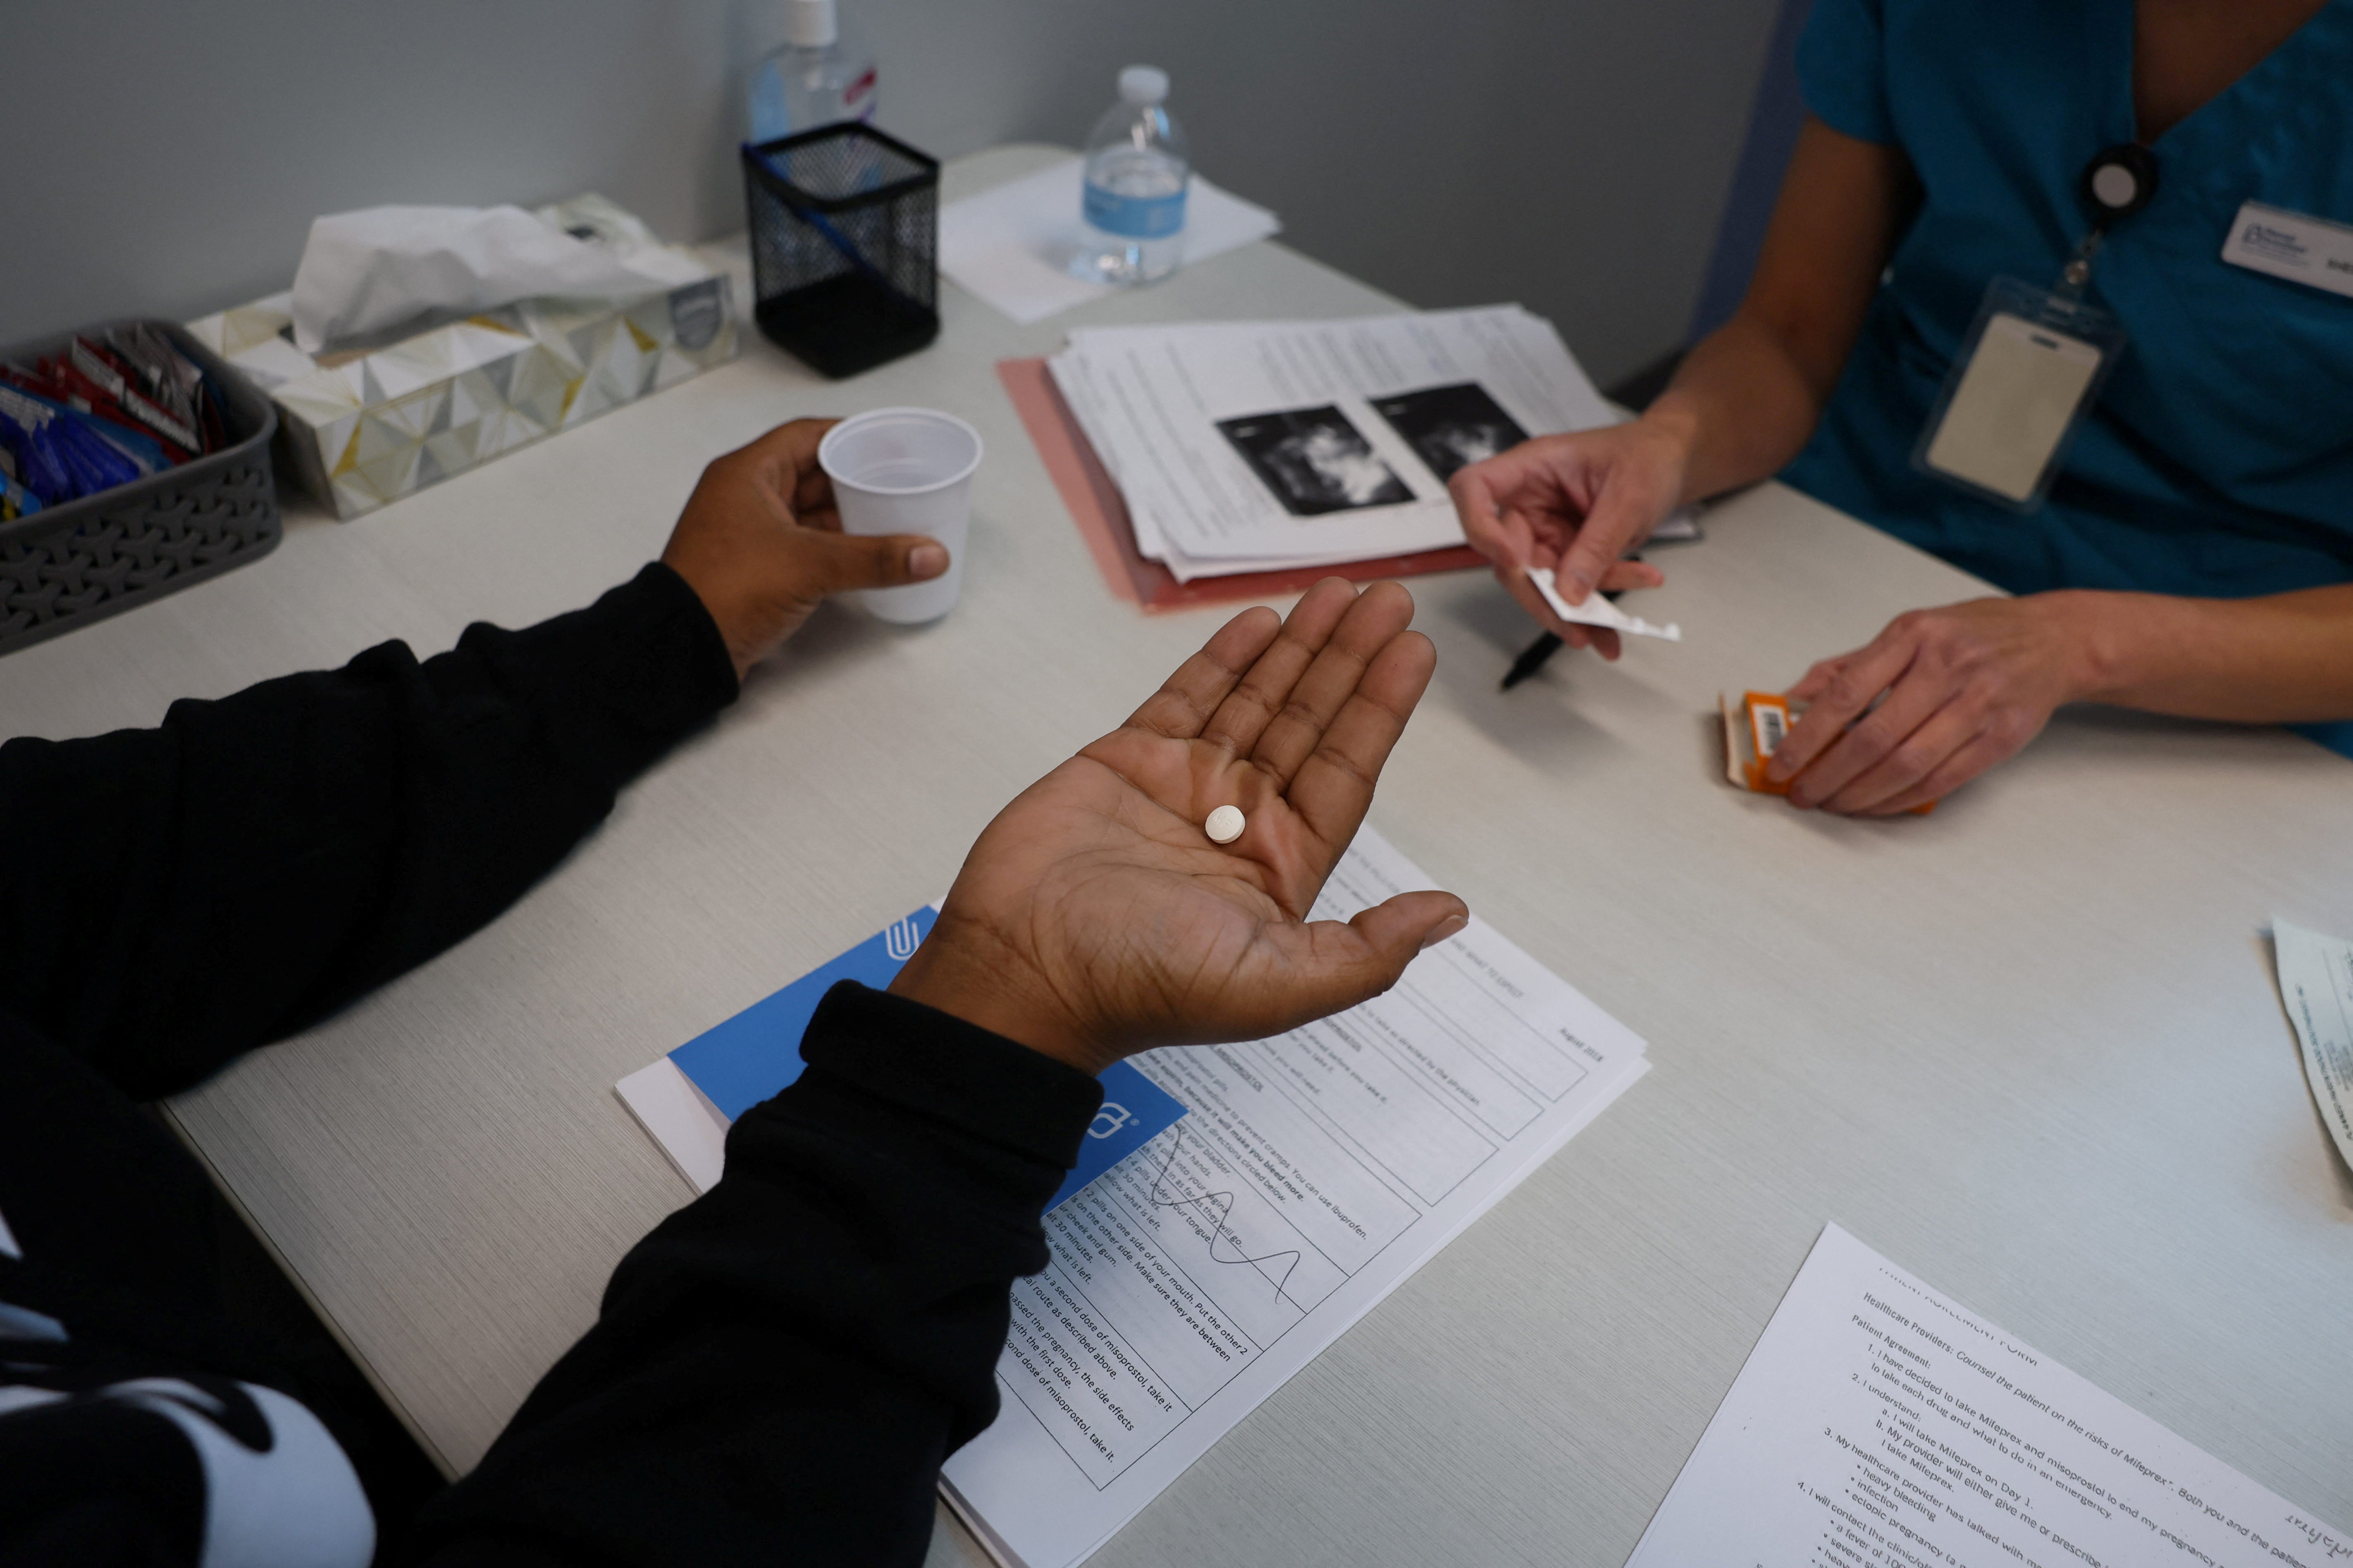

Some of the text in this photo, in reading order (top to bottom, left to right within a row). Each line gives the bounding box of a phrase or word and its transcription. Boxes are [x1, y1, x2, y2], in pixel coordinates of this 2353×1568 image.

[1067, 1213, 1117, 1267] cheek and gum.
[1123, 1192, 1160, 1232] what is left.
[1292, 1168, 1366, 1240] You can use Ibuprofen.
[1054, 1242, 1091, 1284] what is left.
[1055, 1221, 1093, 1263] 30 minutes.
[1091, 1198, 1107, 1212] pills
[1106, 1212, 1117, 1222] on
[1116, 1223, 1130, 1237] one
[1129, 1237, 1145, 1252] side
[1144, 1252, 1156, 1261] of
[1152, 1260, 1170, 1277] your
[1169, 1277, 1193, 1304] mouth.
[1194, 1303, 1209, 1318] Put
[1208, 1316, 1221, 1330] the
[1220, 1330, 1242, 1349] other
[1077, 1203, 1231, 1362] on the other side. Make sure they are between
[1011, 1319, 1071, 1389] with the first dose.
[1033, 1287, 1117, 1380] route as described above.
[1055, 1286, 1083, 1313] second
[1079, 1313, 1098, 1332] dose
[1097, 1332, 1109, 1341] of
[1104, 1340, 1148, 1387] misoprostol,
[1147, 1385, 1165, 1405] take
[1163, 1402, 1172, 1412] it
[1852, 1315, 1931, 1369] Patient Agreement:
[1021, 1358, 1114, 1463] dose of misoprostol, take it.
[1031, 1318, 1045, 1332] the
[1041, 1332, 1081, 1374] pregnancy,
[1081, 1373, 1095, 1388] the
[1093, 1387, 1109, 1404] side
[1108, 1404, 1134, 1431] effects
[1852, 1373, 1859, 1384] 2.
[1869, 1385, 1921, 1422] understand:
[1863, 1292, 1909, 1326] Healthcare
[1911, 1322, 1954, 1354] Providers:
[1957, 1351, 1997, 1379] Counsel
[1996, 1376, 2013, 1390] the
[2013, 1388, 2050, 1413] patient
[2051, 1411, 2065, 1422] on
[2067, 1419, 2083, 1434] the
[2085, 1432, 2109, 1449] risks
[2111, 1448, 2124, 1457] of
[2178, 1488, 2203, 1508] Both
[2203, 1505, 2225, 1521] you
[2226, 1519, 2250, 1536] and
[2250, 1533, 2269, 1549] the
[1868, 1344, 1874, 1354] 1.
[1883, 1354, 1904, 1371] have
[1905, 1369, 1943, 1395] decided
[1979, 1413, 2022, 1445] Mifeprex
[2024, 1443, 2045, 1459] and
[2047, 1458, 2105, 1497] misoprostol
[2119, 1503, 2139, 1518] end
[2141, 1517, 2158, 1531] my
[1902, 1384, 1924, 1401] each
[1926, 1399, 1948, 1418] drug
[1950, 1414, 1971, 1429] and
[1973, 1427, 1996, 1446] what
[2011, 1451, 2024, 1463] do
[2027, 1459, 2036, 1472] in
[2039, 1470, 2052, 1481] an
[2055, 1480, 2112, 1520] emergency.
[1824, 1427, 2023, 1561] 3. My healthcare provider has talked with
[1857, 1479, 1898, 1512] infection
[1863, 1467, 1936, 1522] heavy bleeding
[1887, 1443, 1907, 1461] take
[1909, 1458, 1954, 1492] Mifeprex.
[1887, 1426, 1902, 1442] My
[1903, 1439, 1944, 1467] provider
[1946, 1465, 1963, 1480] will
[1964, 1478, 1994, 1500] either
[1995, 1498, 2017, 1516] give
[2020, 1513, 2037, 1528] me
[2039, 1526, 2050, 1536] or
[2052, 1534, 2102, 1568] prescribe
[1900, 1419, 1915, 1432] will
[1916, 1429, 1936, 1447] take
[1939, 1443, 1982, 1477] Mifeprex
[1985, 1475, 1997, 1486] on
[2001, 1482, 2021, 1501] Day
[2024, 1497, 2033, 1509] 1.
[1797, 1482, 1805, 1492] 4.
[1815, 1493, 1830, 1507] will
[1831, 1504, 1867, 1532] contact
[1869, 1527, 1884, 1543] the
[1845, 1529, 1870, 1550] fever
[1872, 1548, 1883, 1558] of
[1852, 1494, 1956, 1566] ectopic pregnancy (a
[1830, 1538, 1862, 1563] severe
